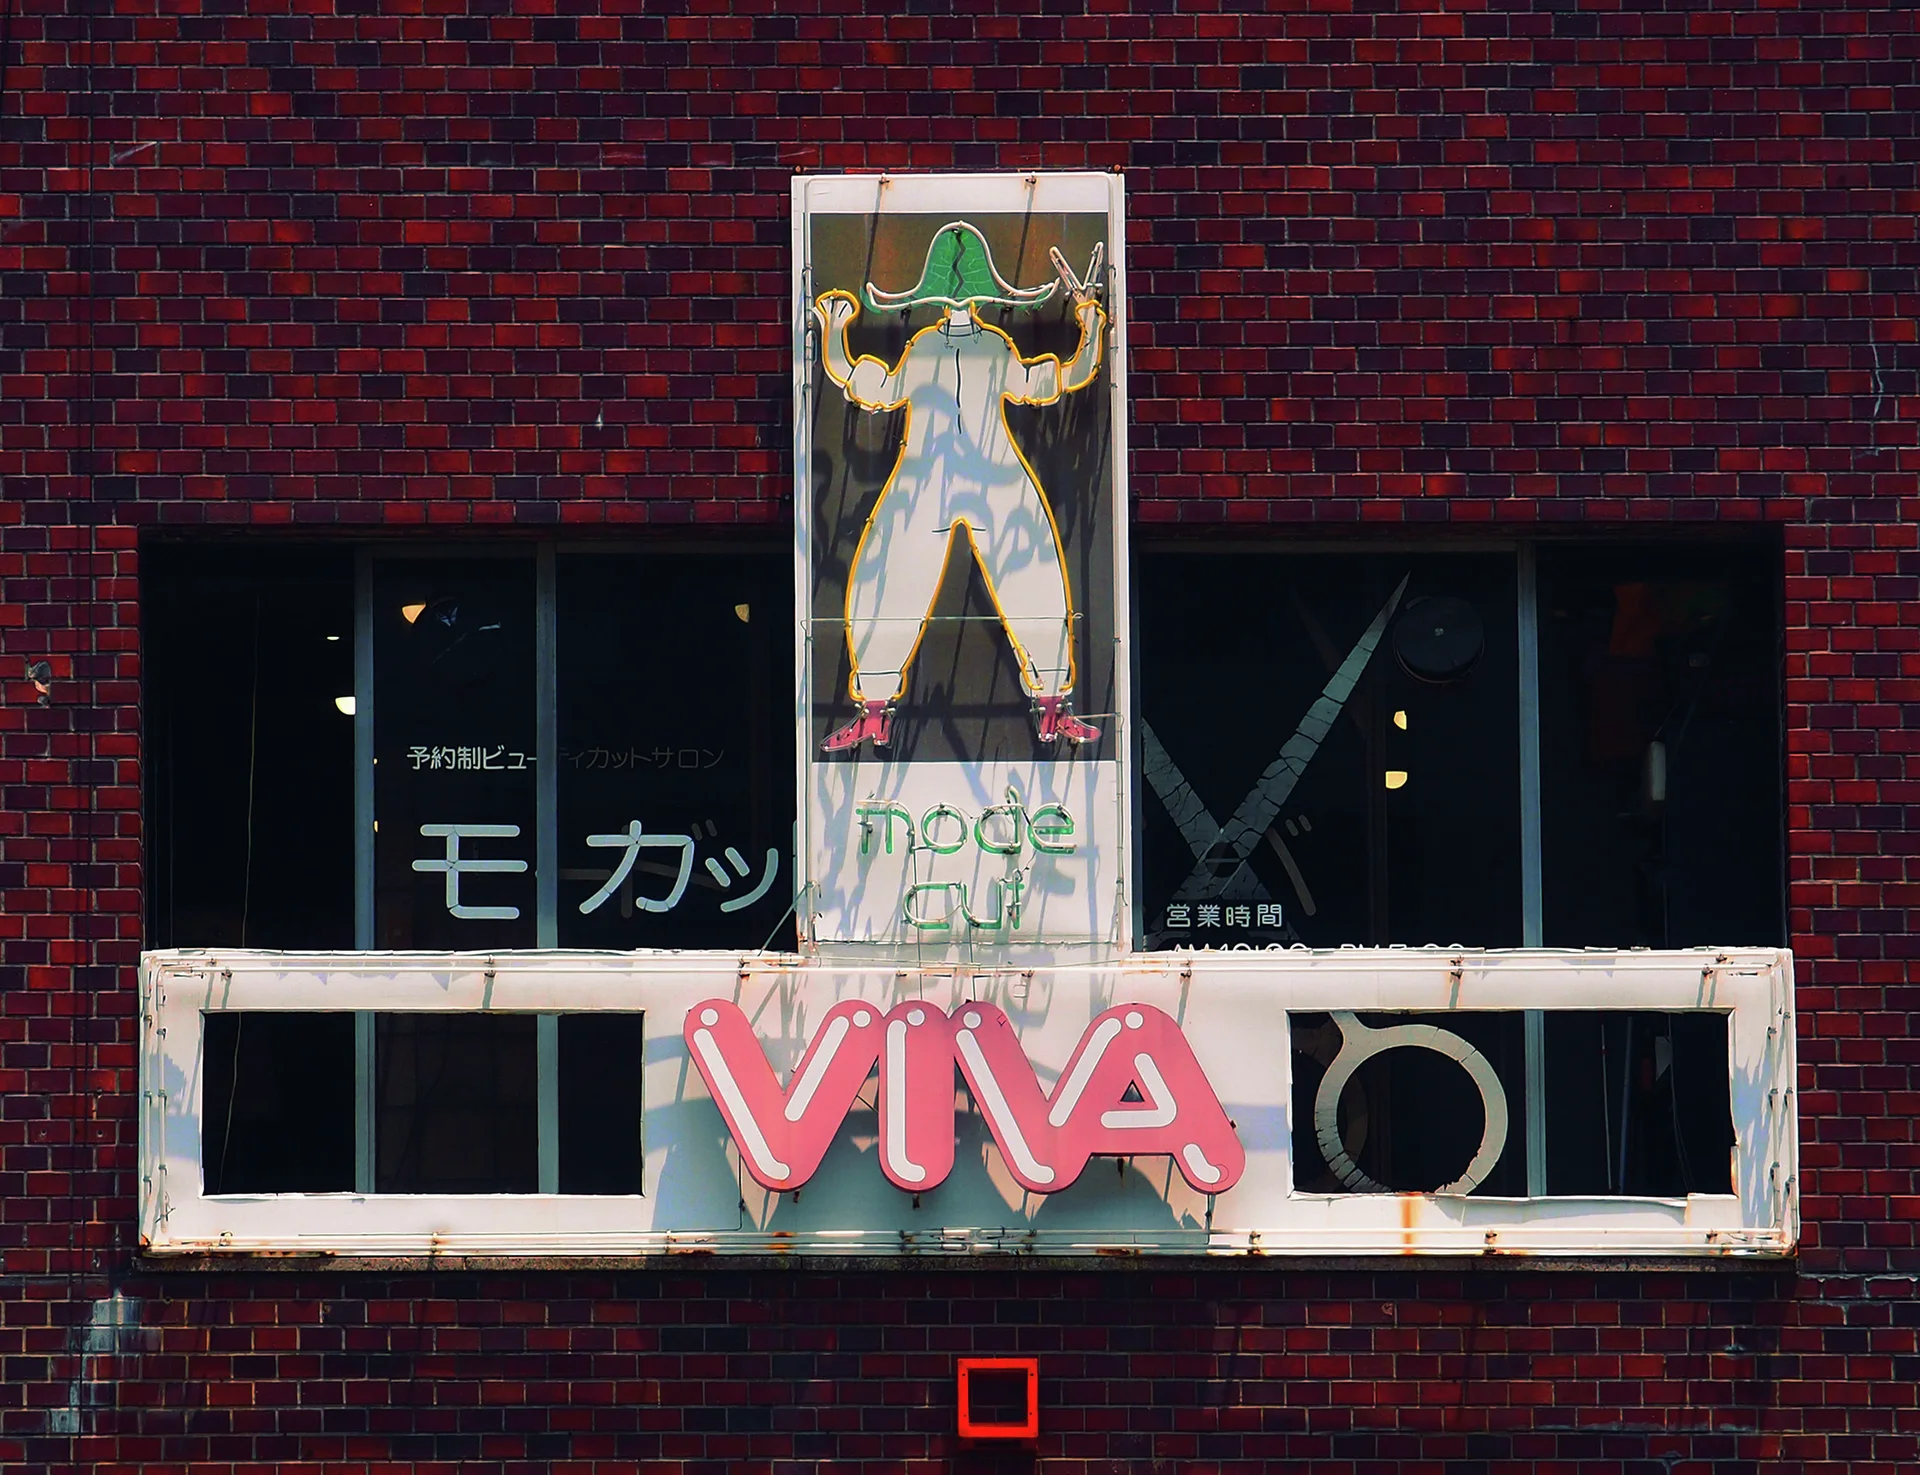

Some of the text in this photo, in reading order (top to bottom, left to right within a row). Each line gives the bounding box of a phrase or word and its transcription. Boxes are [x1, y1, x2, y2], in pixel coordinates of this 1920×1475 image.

[855, 785, 1077, 855] mode
[902, 868, 1026, 930] cut
[1165, 903, 1284, 929] 営業時間
[683, 998, 1246, 1195] VIVA
